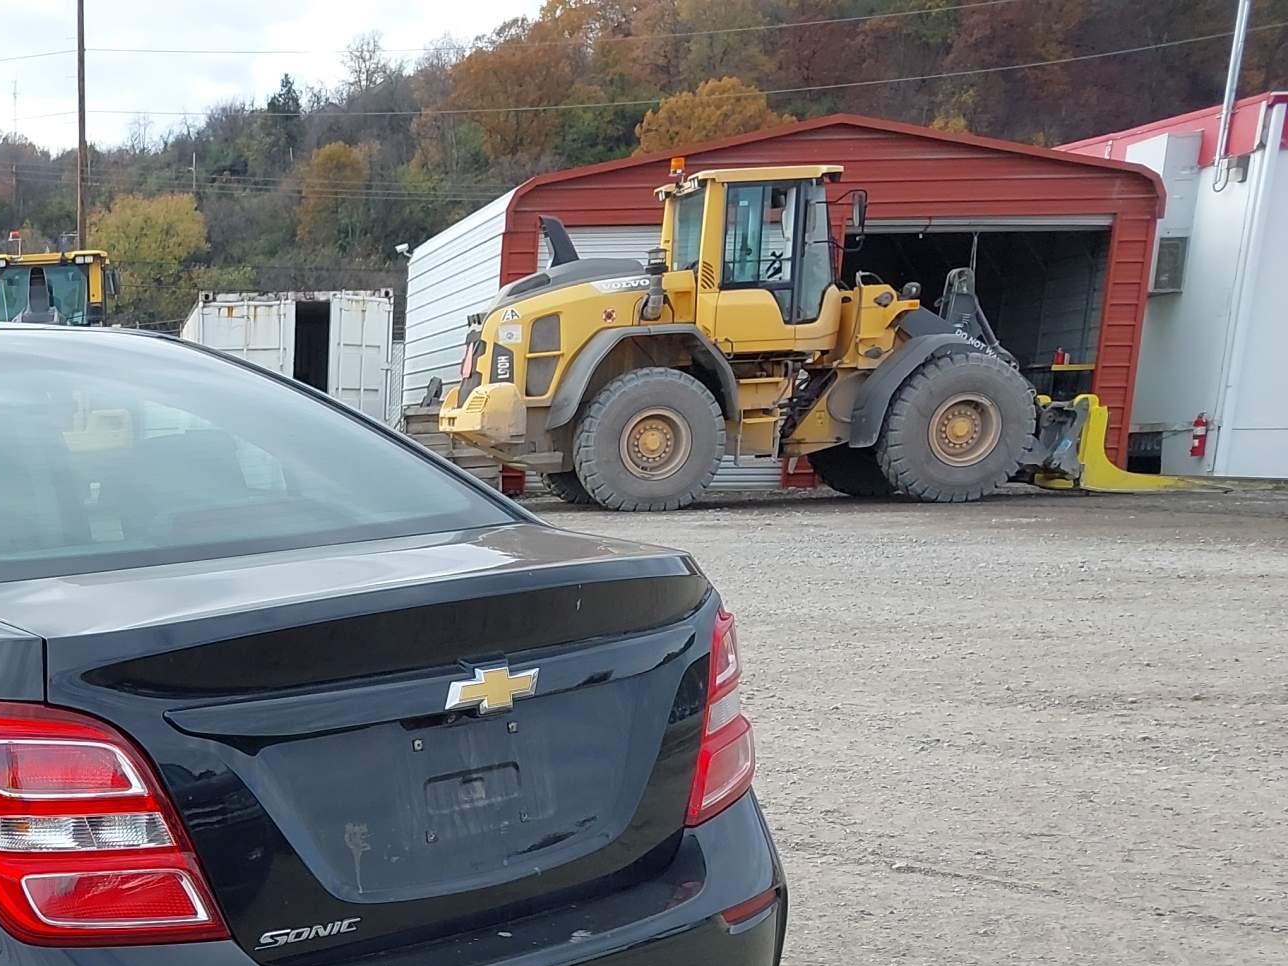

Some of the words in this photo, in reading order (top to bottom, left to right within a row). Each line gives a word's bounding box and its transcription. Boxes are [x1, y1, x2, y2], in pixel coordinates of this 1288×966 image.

[601, 279, 650, 290] VOLVO
[955, 328, 968, 340] DO
[968, 336, 987, 351] NOT
[255, 917, 361, 951] SONIC
